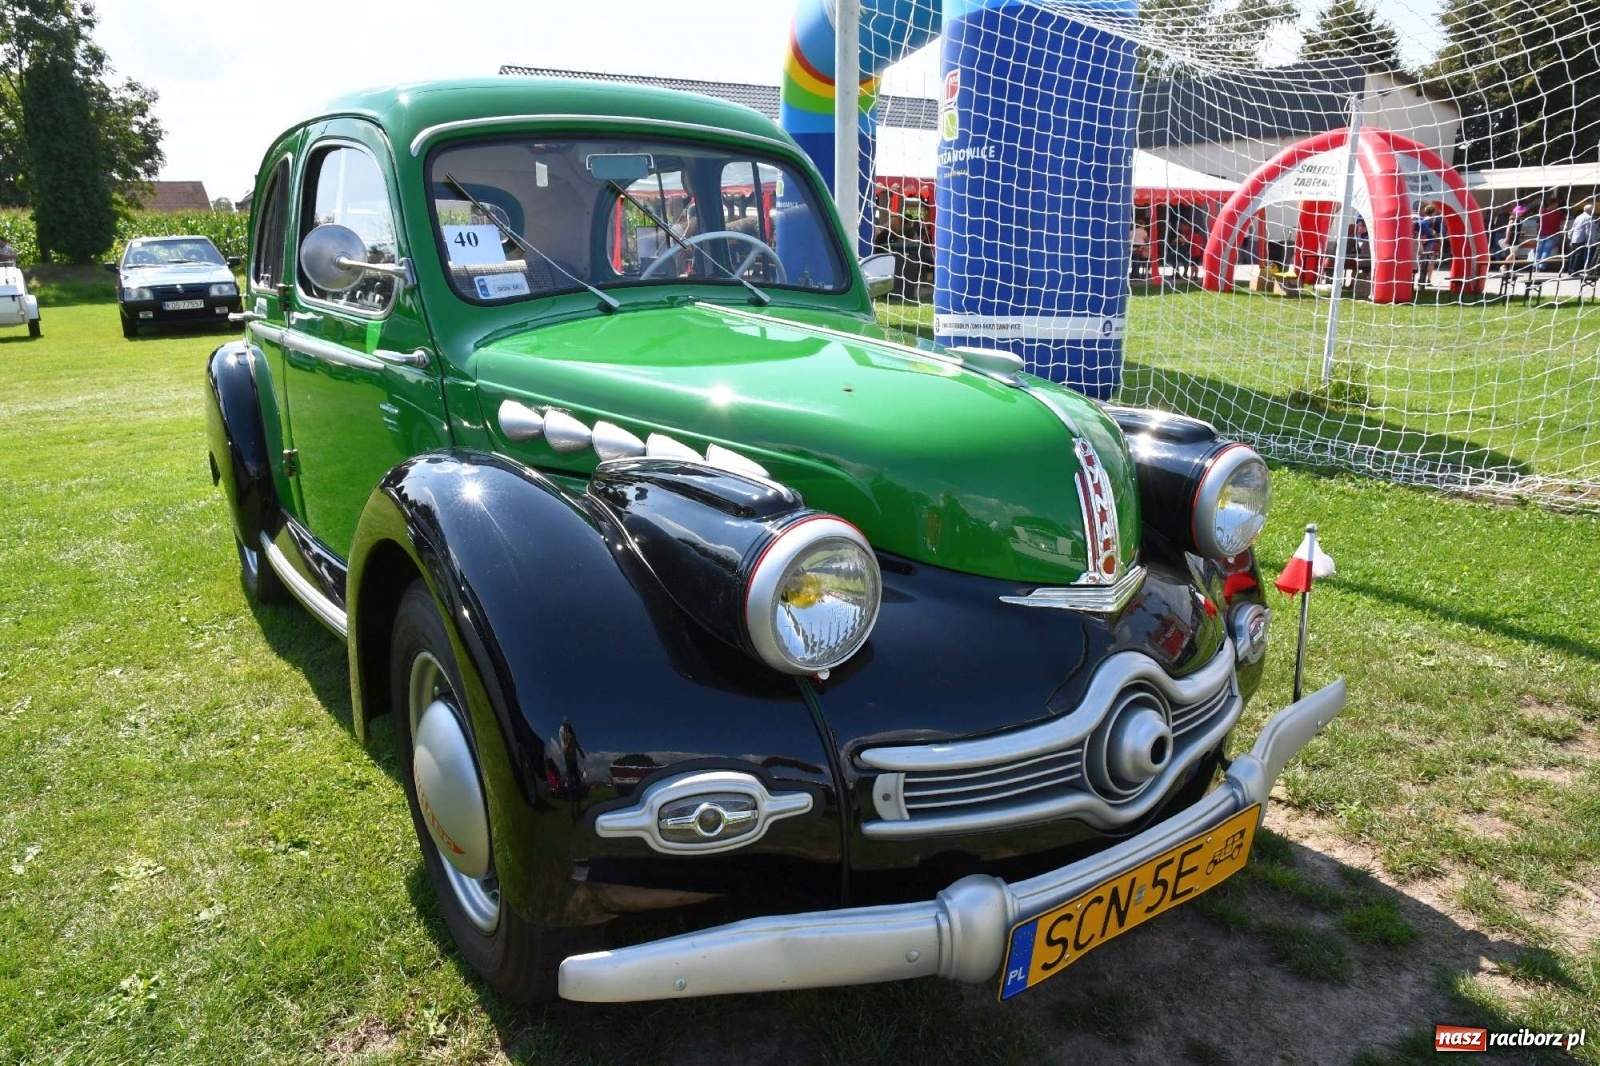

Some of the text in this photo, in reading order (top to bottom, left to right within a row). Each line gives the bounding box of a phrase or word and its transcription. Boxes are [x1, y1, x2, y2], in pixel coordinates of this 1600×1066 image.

[454, 231, 479, 247] 40
[1007, 844, 1203, 986] PL SCN 5E
